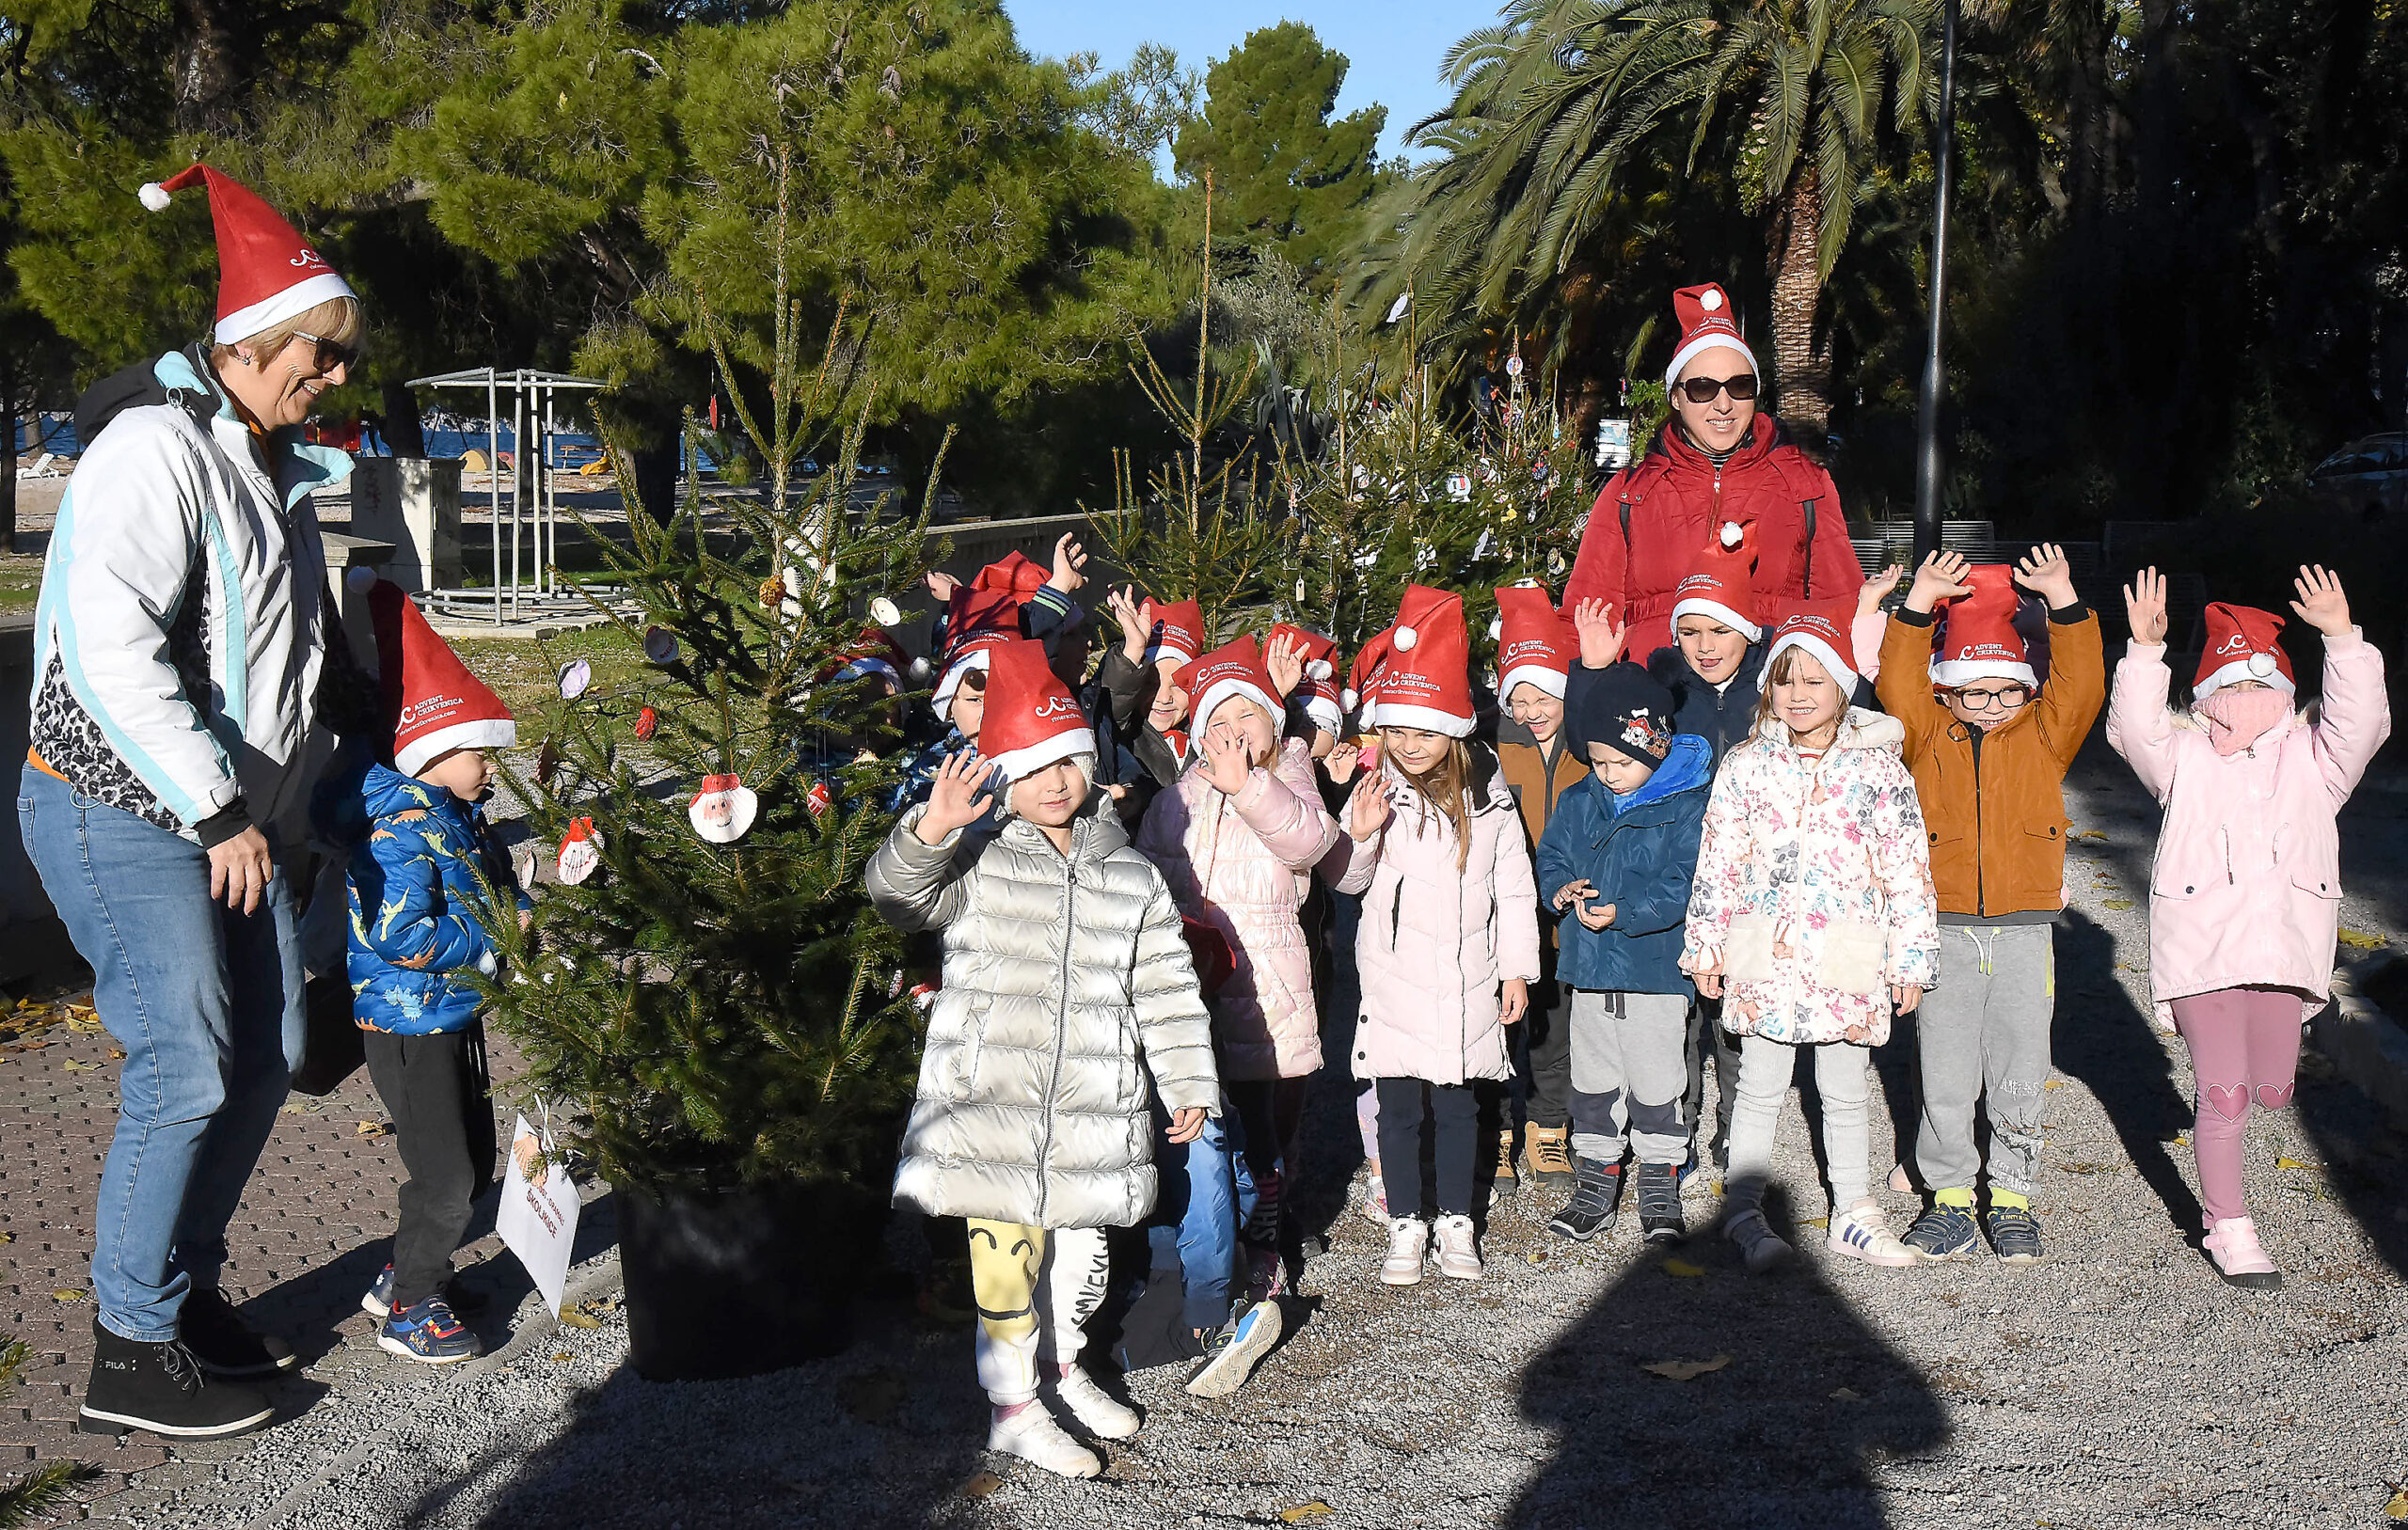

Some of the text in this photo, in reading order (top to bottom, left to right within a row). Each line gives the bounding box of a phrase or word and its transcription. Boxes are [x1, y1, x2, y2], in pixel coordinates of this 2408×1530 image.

[1976, 649, 2018, 658] CRIKVENICA
[1400, 672, 1428, 682] ADVENT
[1400, 679, 1442, 692] CRIKVENICA
[414, 694, 444, 712] ADVENT
[417, 697, 465, 717] CRIKVENICA
[104, 1361, 126, 1370] FILA
